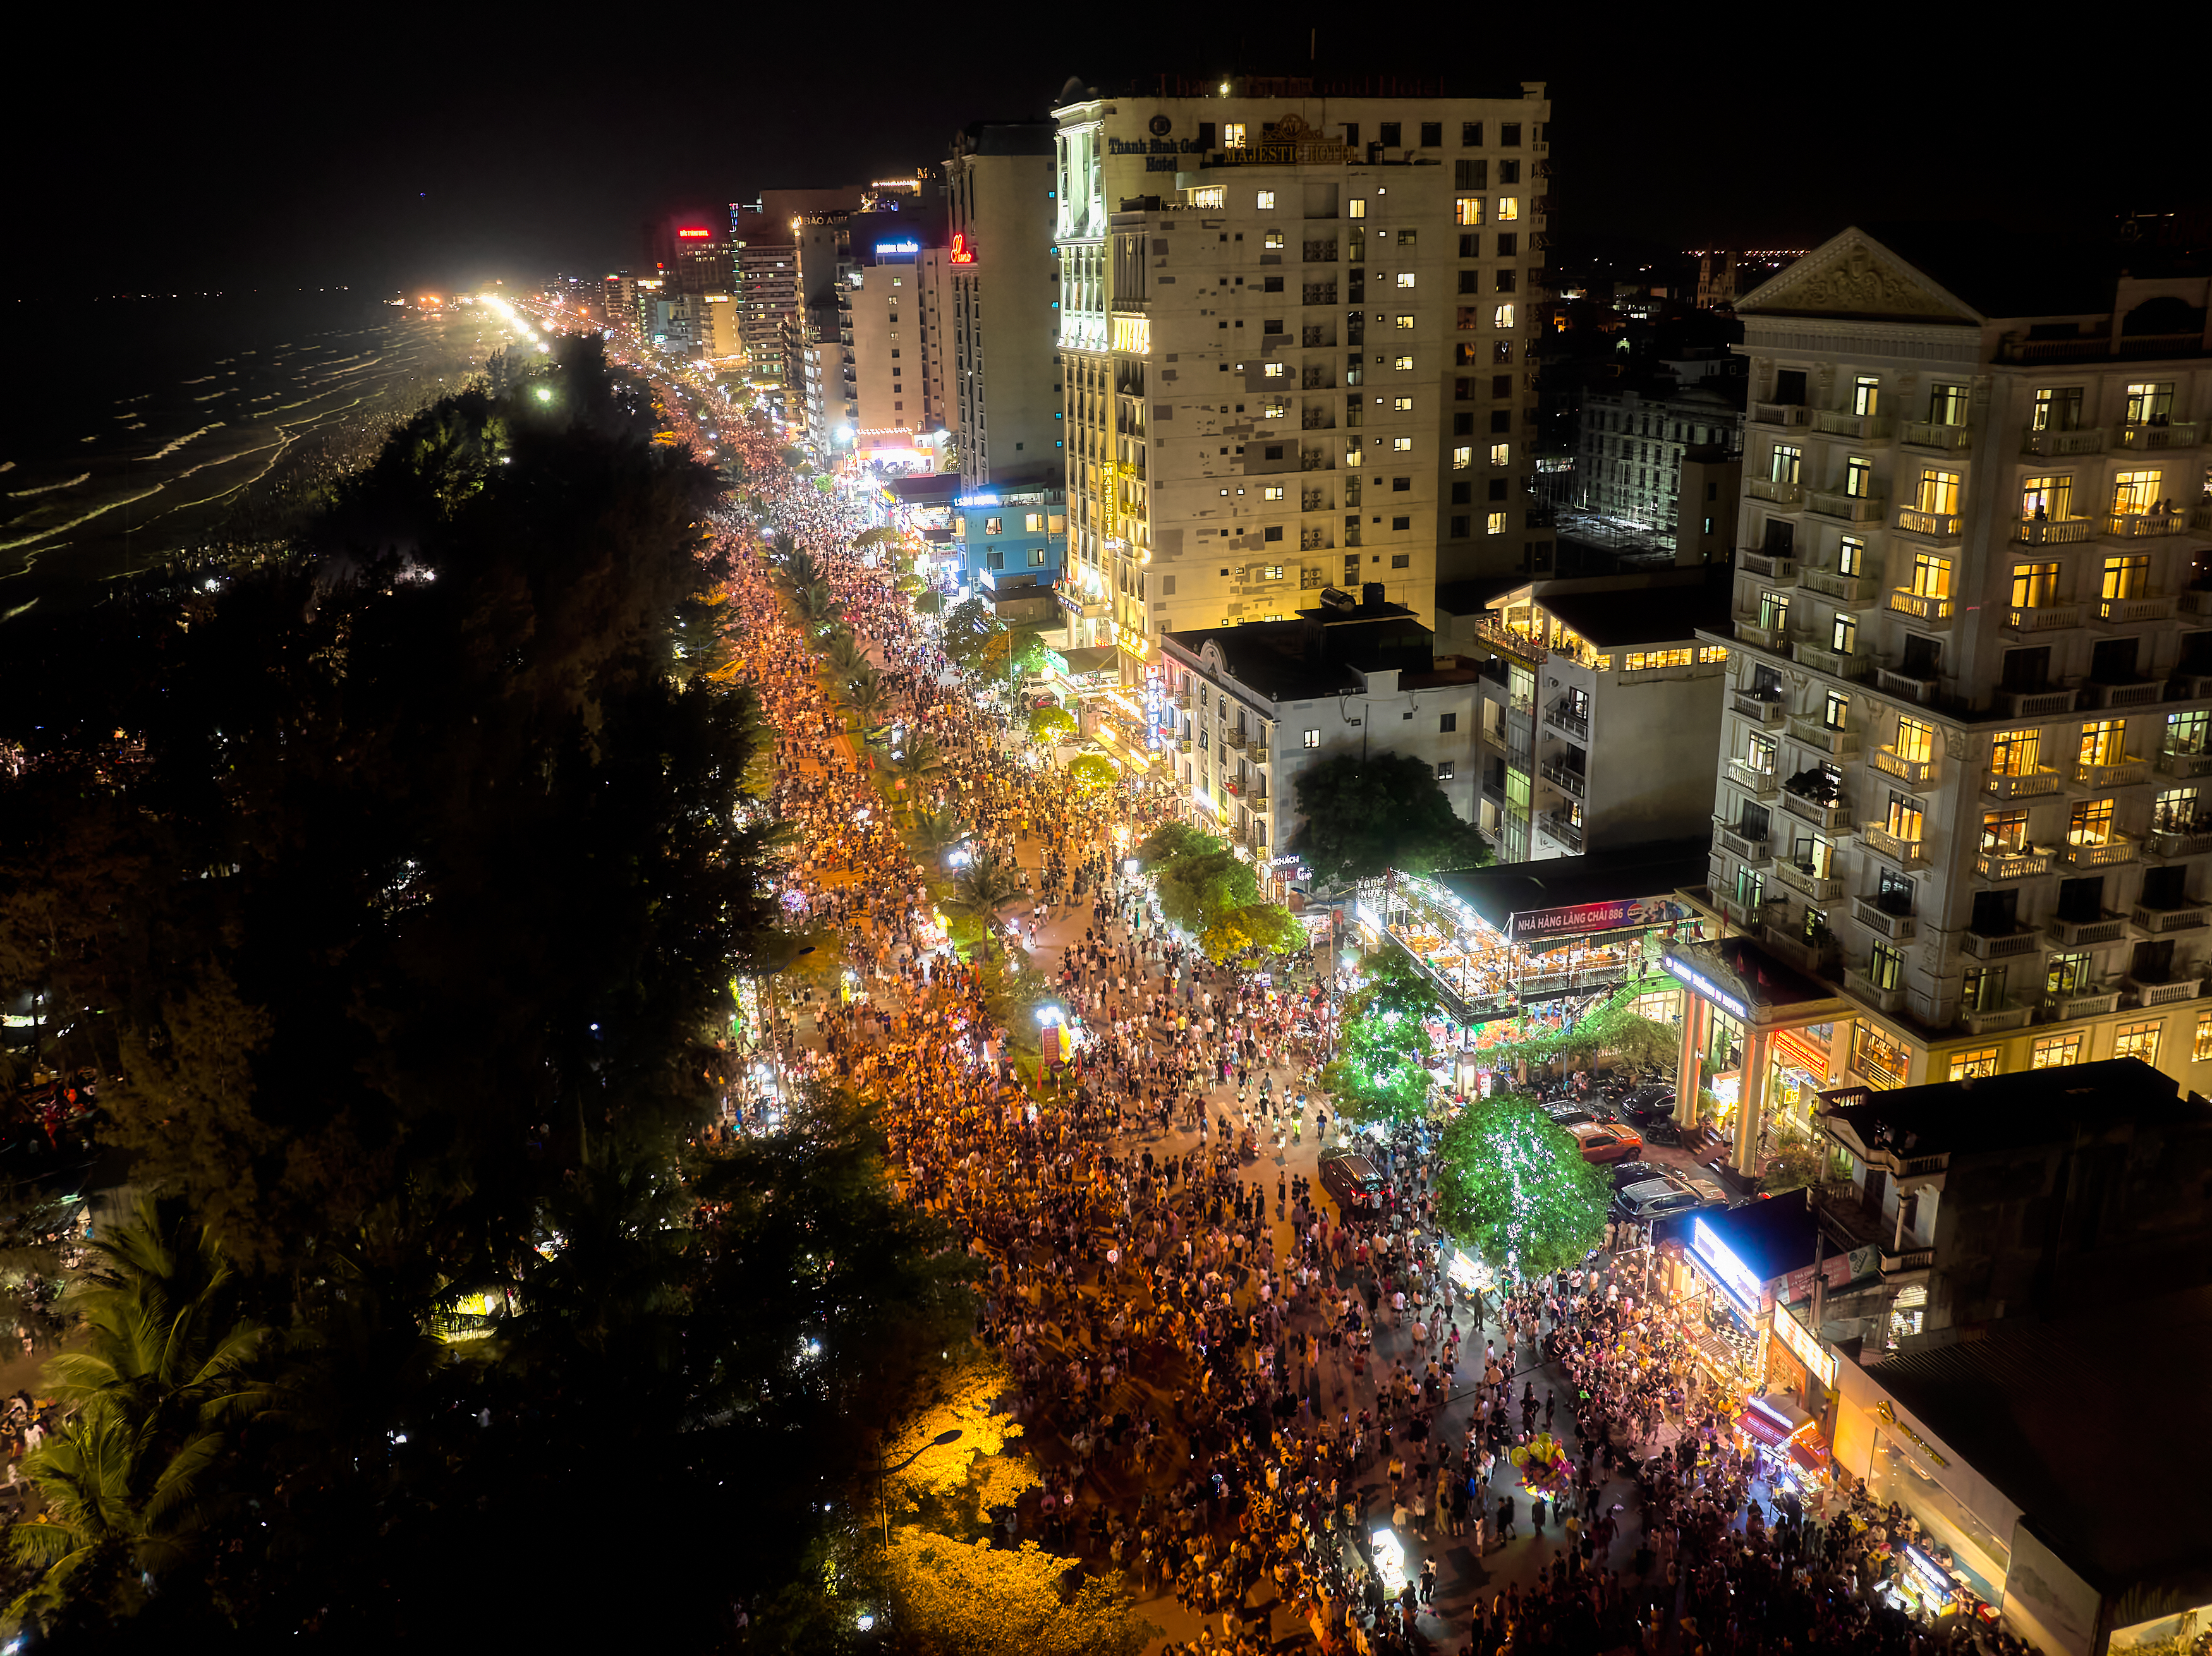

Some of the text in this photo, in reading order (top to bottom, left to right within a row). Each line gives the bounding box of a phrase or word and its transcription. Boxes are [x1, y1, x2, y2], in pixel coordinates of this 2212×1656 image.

[1145, 156, 1178, 172] Hotel
[1224, 145, 1356, 163] MAJESTIC HOTEL
[1103, 466, 1114, 541] MAJESTIC
[1517, 916, 1536, 931] NHÀ
[1538, 914, 1562, 929] HÀNG
[1563, 911, 1586, 925] LÀNG
[1587, 907, 1607, 922] CHÀI
[1608, 908, 1624, 919] 886
